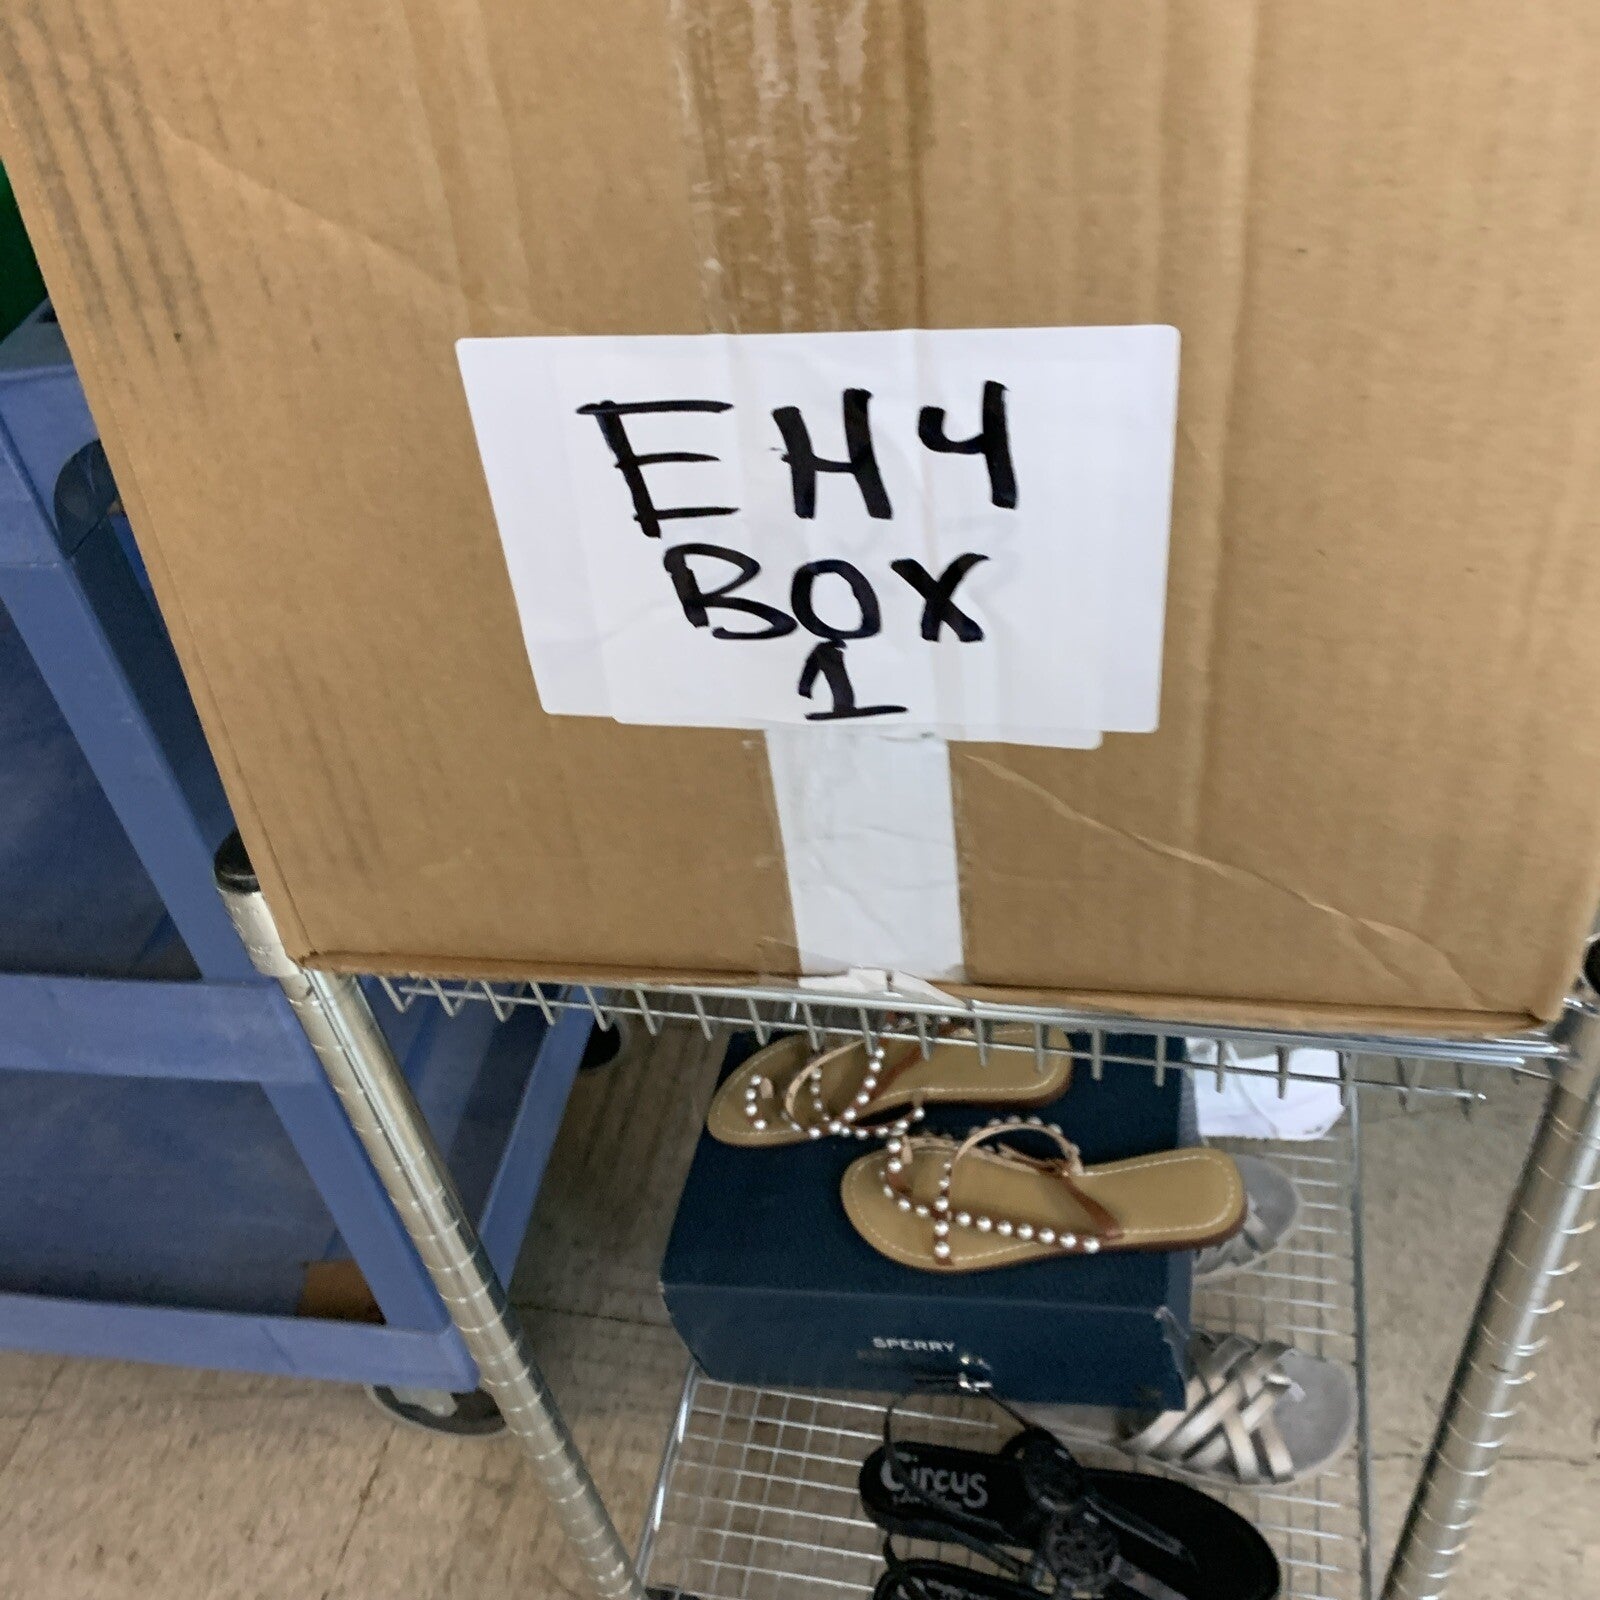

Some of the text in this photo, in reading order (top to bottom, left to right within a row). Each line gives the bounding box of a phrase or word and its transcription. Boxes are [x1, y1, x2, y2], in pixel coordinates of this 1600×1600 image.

[662, 543, 990, 643] BOX
[798, 640, 908, 721] 1
[872, 1336, 955, 1352] SPERRY
[880, 1451, 989, 1509] Circus
